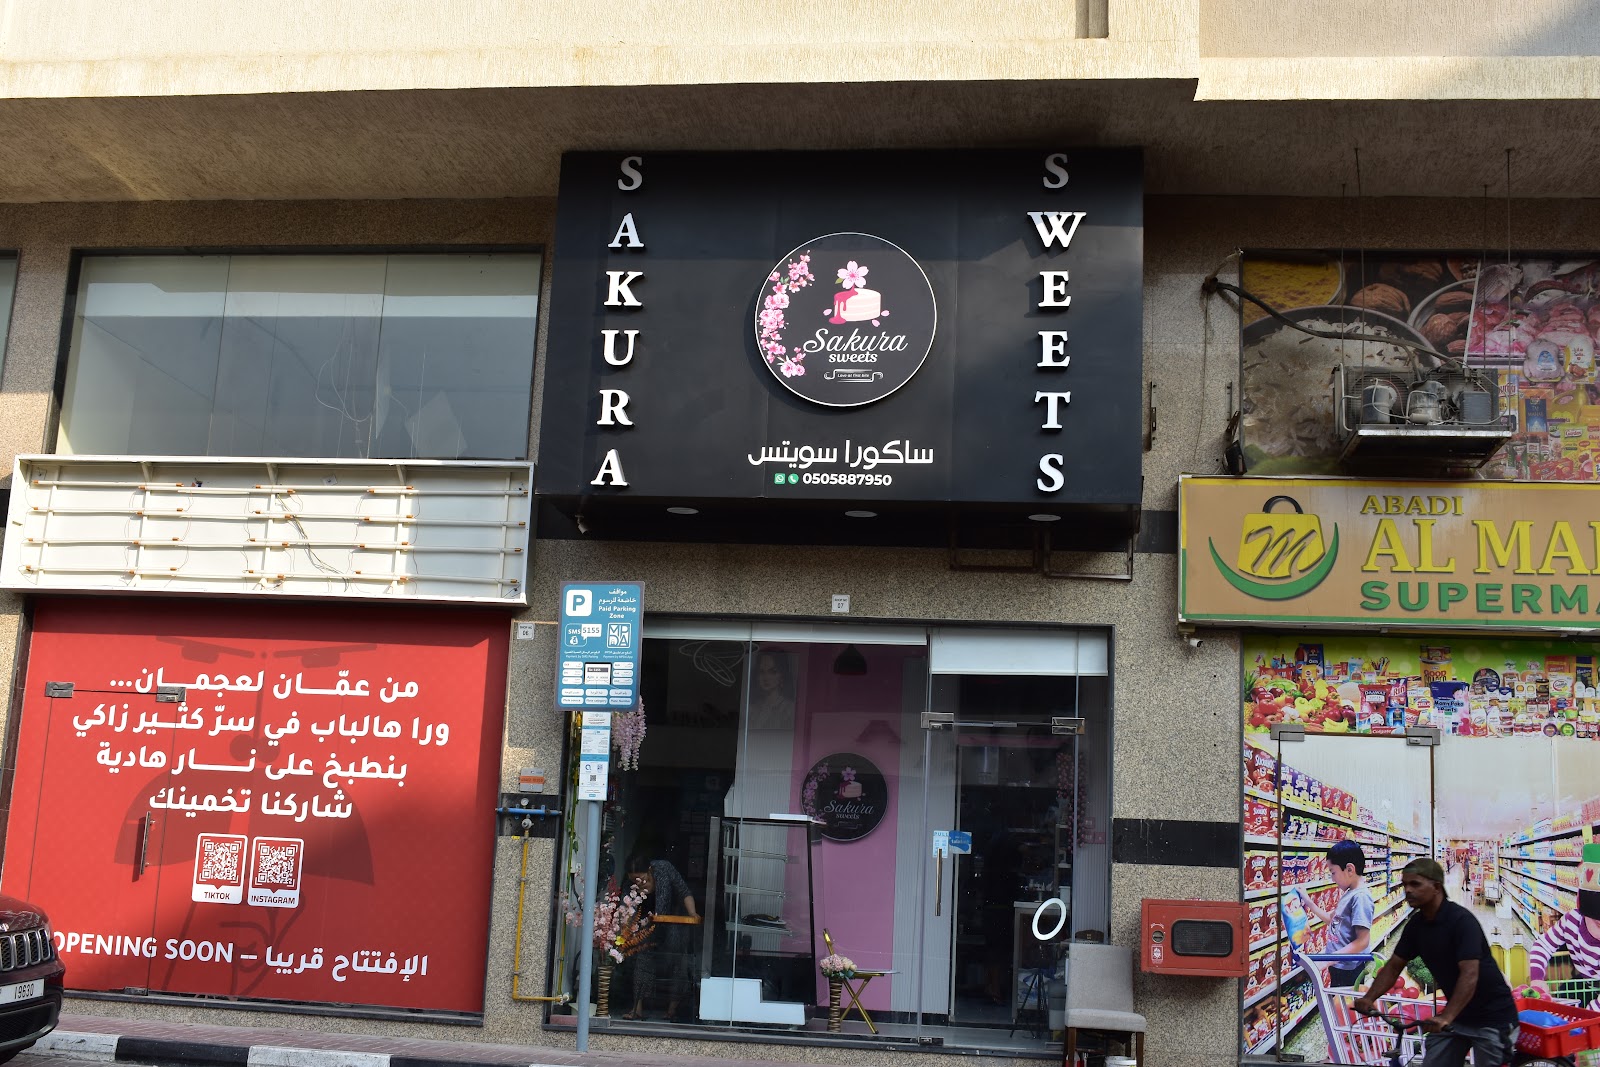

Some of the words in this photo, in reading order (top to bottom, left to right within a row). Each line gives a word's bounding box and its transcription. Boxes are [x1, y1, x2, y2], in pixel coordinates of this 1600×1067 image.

[590, 155, 646, 487] SAKURA
[1026, 152, 1088, 493] SWEETS
[803, 328, 908, 353] Sakura
[828, 351, 878, 363] sweets
[747, 440, 837, 469] سويتس
[845, 440, 934, 470] ساكورا
[802, 473, 893, 486] 0505887950
[1360, 495, 1464, 515] ABADI
[1361, 518, 1456, 573] AL
[572, 594, 586, 612] P
[1359, 580, 1600, 615] SUPERM
[380, 676, 419, 703] من
[73, 703, 128, 737] زاكي
[132, 702, 204, 734] كثير
[264, 711, 300, 746] في
[310, 714, 402, 744] هالباب
[412, 716, 450, 746] ورا
[96, 742, 166, 773] هادية
[171, 748, 256, 775] نار
[265, 752, 314, 780] على
[322, 752, 407, 788] بنطبخ
[149, 786, 251, 817] تخمينك
[261, 790, 353, 823] شاركنا
[824, 800, 874, 814] Sakura
[204, 892, 230, 900] TIKTOK
[251, 896, 296, 904] INSTAGRAM
[165, 938, 234, 963] SOON
[265, 946, 324, 975] قريبا
[332, 950, 428, 982] الإفتتاح
